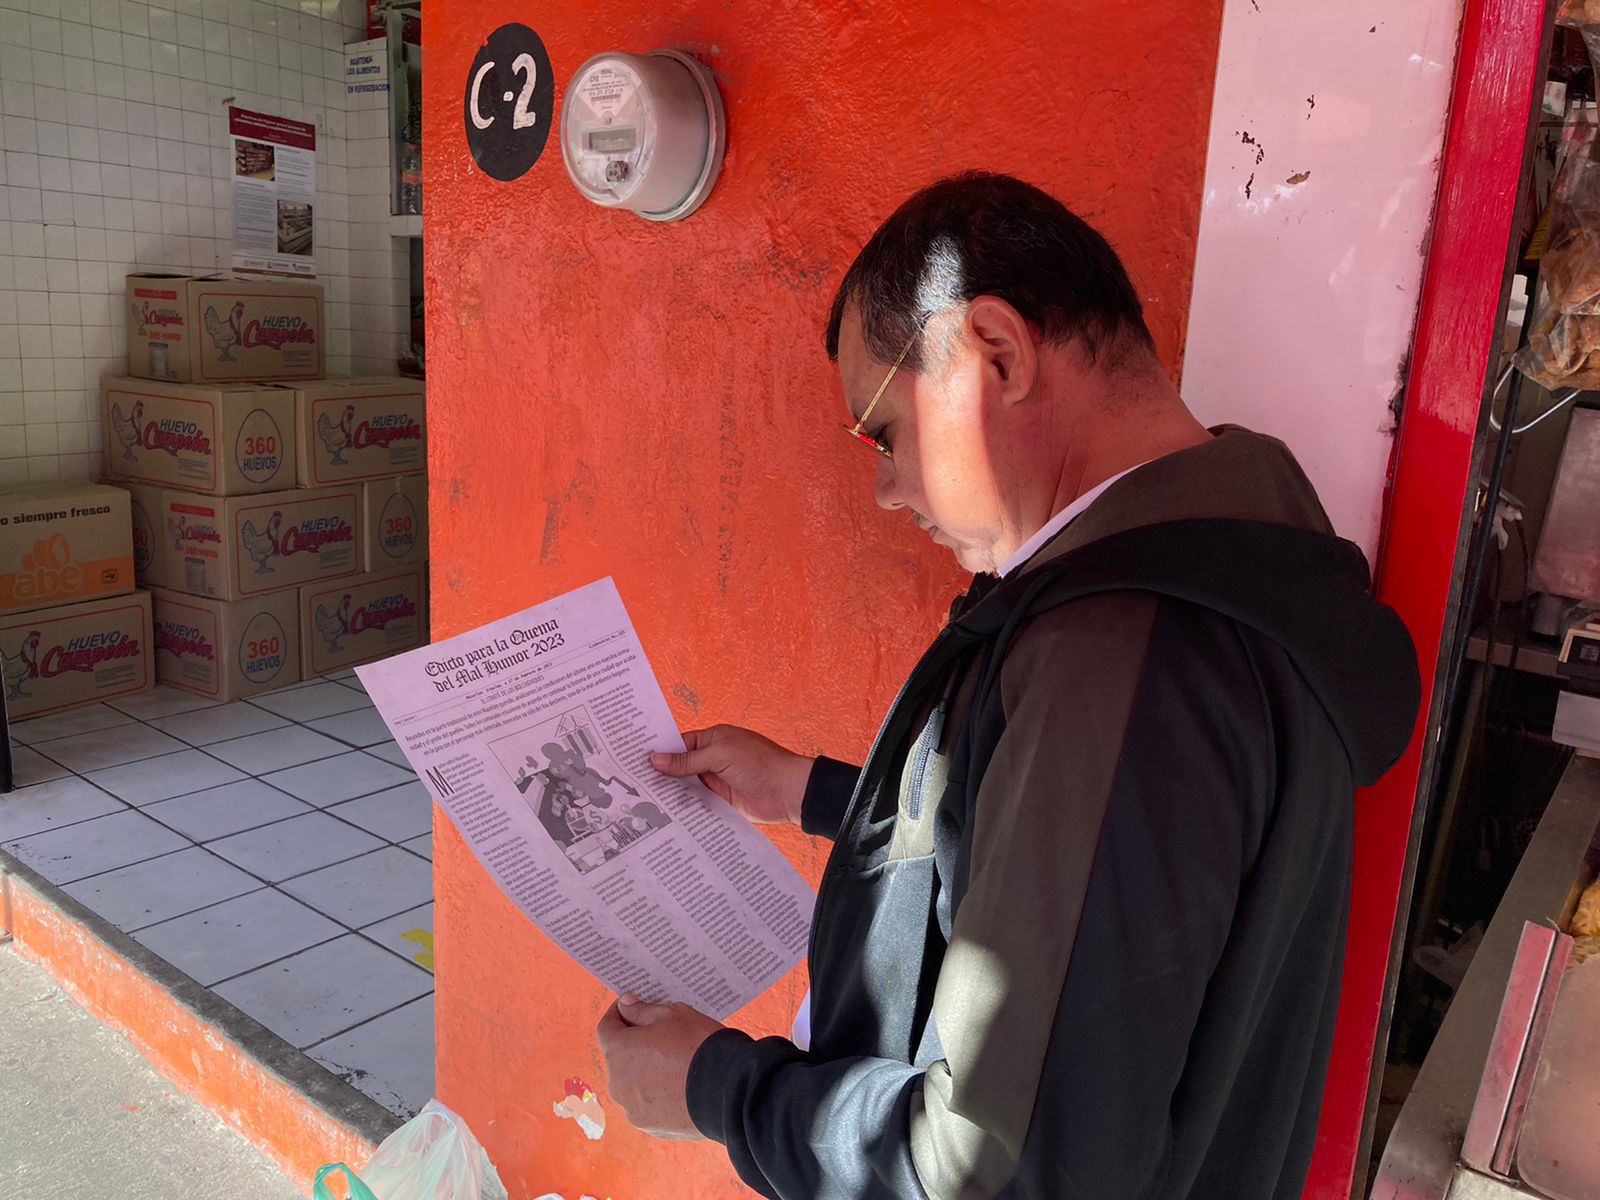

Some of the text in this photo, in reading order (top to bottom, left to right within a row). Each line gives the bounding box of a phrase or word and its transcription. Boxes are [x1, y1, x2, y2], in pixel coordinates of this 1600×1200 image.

[262, 315, 301, 328] HUEVO
[243, 319, 316, 350] Campeón
[160, 418, 197, 435] HUEVO
[372, 414, 408, 428] HUEVO
[142, 421, 212, 457] Campeón
[354, 418, 421, 450] Campeón
[244, 436, 276, 455] 360
[243, 456, 277, 471] HUEVOS
[14, 512, 68, 526] siempre
[70, 504, 110, 518] fresco
[301, 516, 340, 532] HUEVO
[386, 517, 412, 535] 360
[281, 521, 354, 556] Campeón
[385, 532, 413, 548] HUEVOS
[368, 594, 404, 612] HUEVO
[350, 598, 416, 635] Campeón
[164, 622, 200, 638] HUEVO
[67, 630, 121, 652] HUEVO
[248, 637, 279, 656] 360
[424, 618, 560, 677] Edicto para la Quema
[40, 635, 140, 678] Campeón
[246, 656, 280, 674] HUEVOS
[433, 634, 565, 694] del Mal Humor 2023
